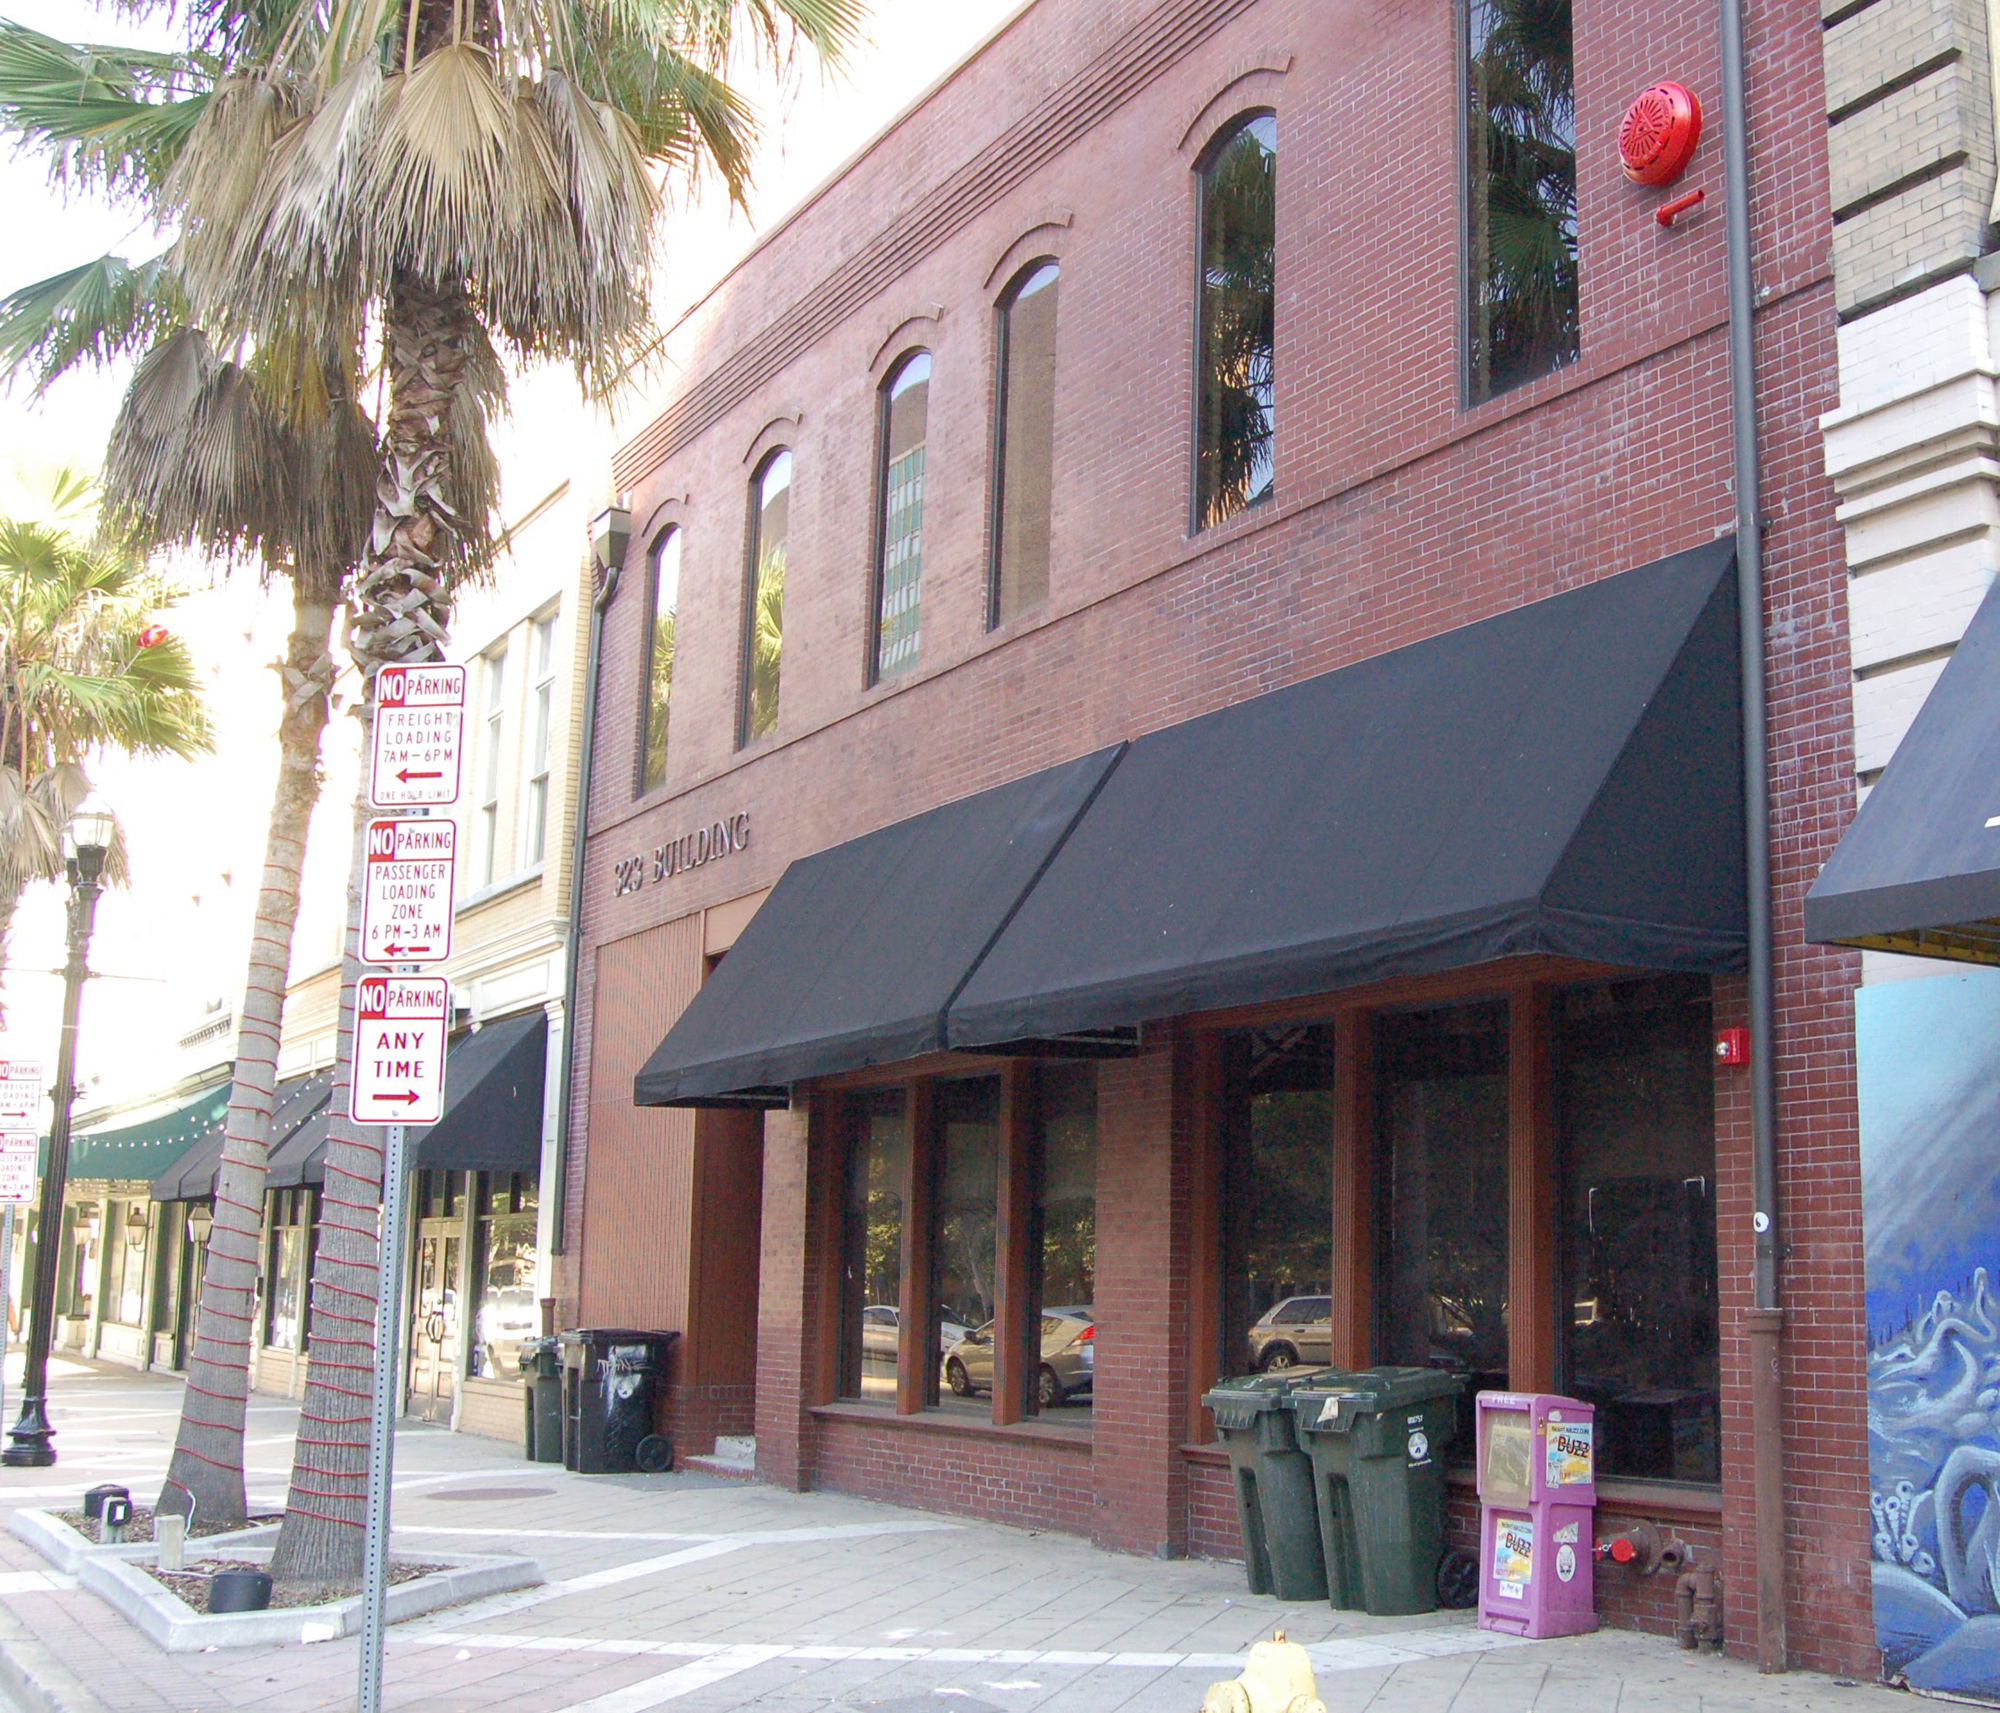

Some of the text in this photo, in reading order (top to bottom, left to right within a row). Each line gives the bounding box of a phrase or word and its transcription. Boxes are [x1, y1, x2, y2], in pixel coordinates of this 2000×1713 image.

[380, 674, 461, 701] NO PARKING
[388, 712, 451, 726] FREIGHT
[386, 730, 451, 745] LOADING
[380, 789, 450, 800] ONE HOR LIMIT
[369, 828, 451, 855] NO PARKING
[613, 811, 750, 897] 323 BUILDING
[375, 864, 446, 880] PASSENGER
[382, 884, 436, 900] LOADING
[391, 904, 424, 919] ZONE
[360, 984, 443, 1012] NO PARKING
[376, 1032, 425, 1050] ANY
[10, 1066, 40, 1075] PARKING
[374, 1060, 425, 1078] TIME
[5, 1138, 35, 1147] PARKING
[1557, 1434, 1590, 1458] BUZZ
[1505, 1532, 1532, 1558] BUZZ
